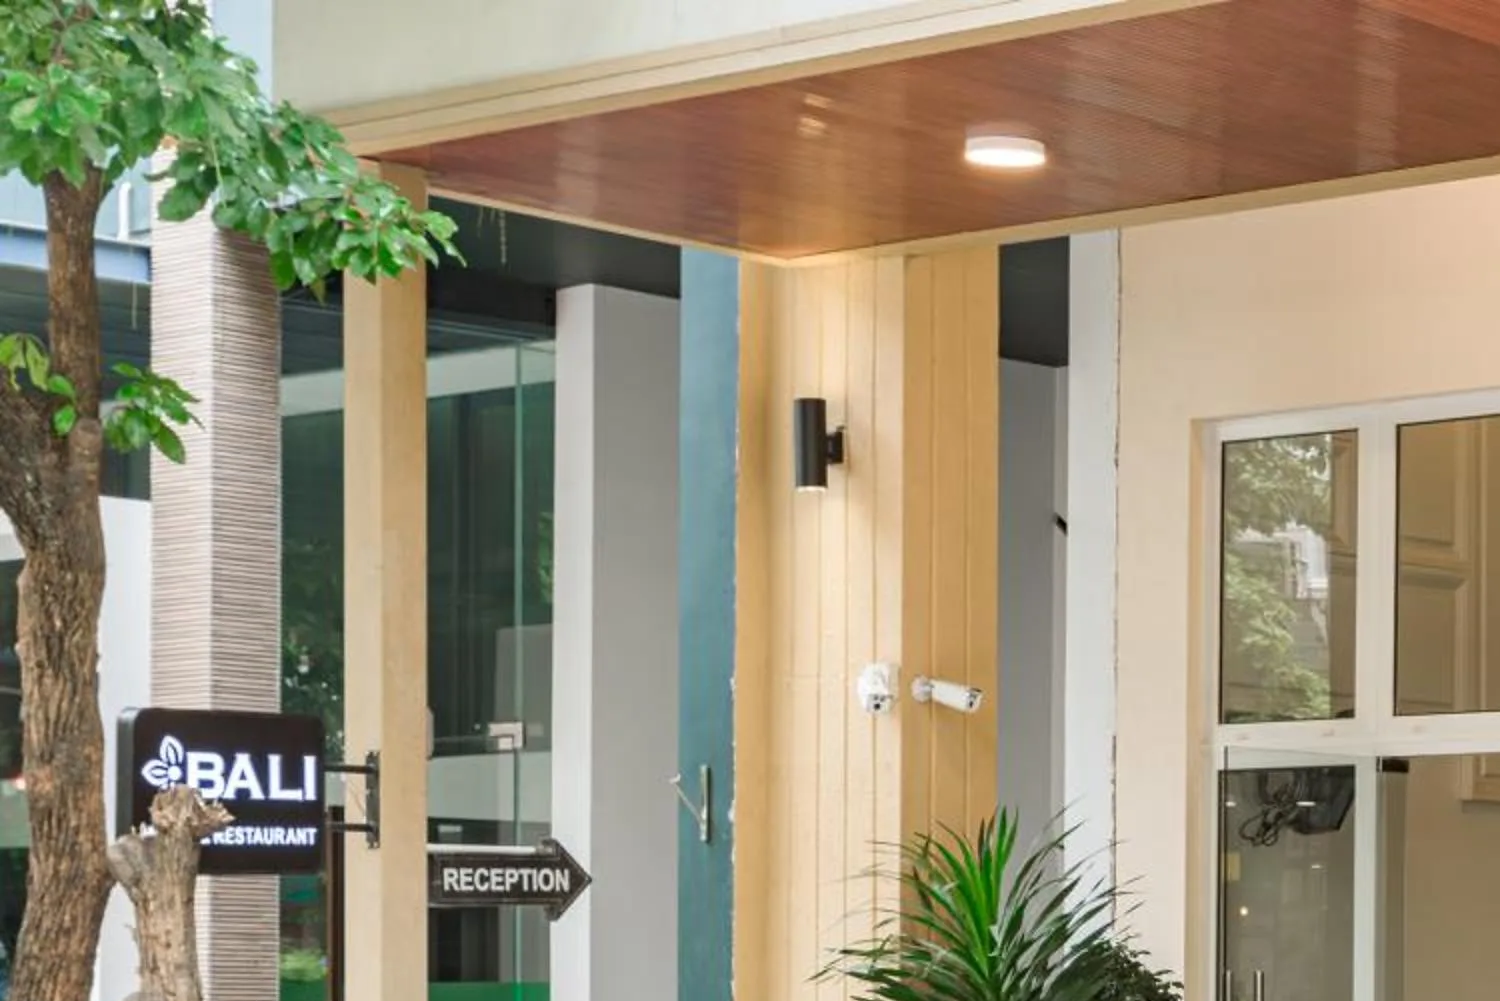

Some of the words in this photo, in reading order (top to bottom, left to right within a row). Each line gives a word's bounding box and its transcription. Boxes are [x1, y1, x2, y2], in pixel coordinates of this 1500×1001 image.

[186, 751, 317, 801] BALI
[212, 826, 318, 846] RESTAURANT
[442, 867, 570, 893] RECEPTION
